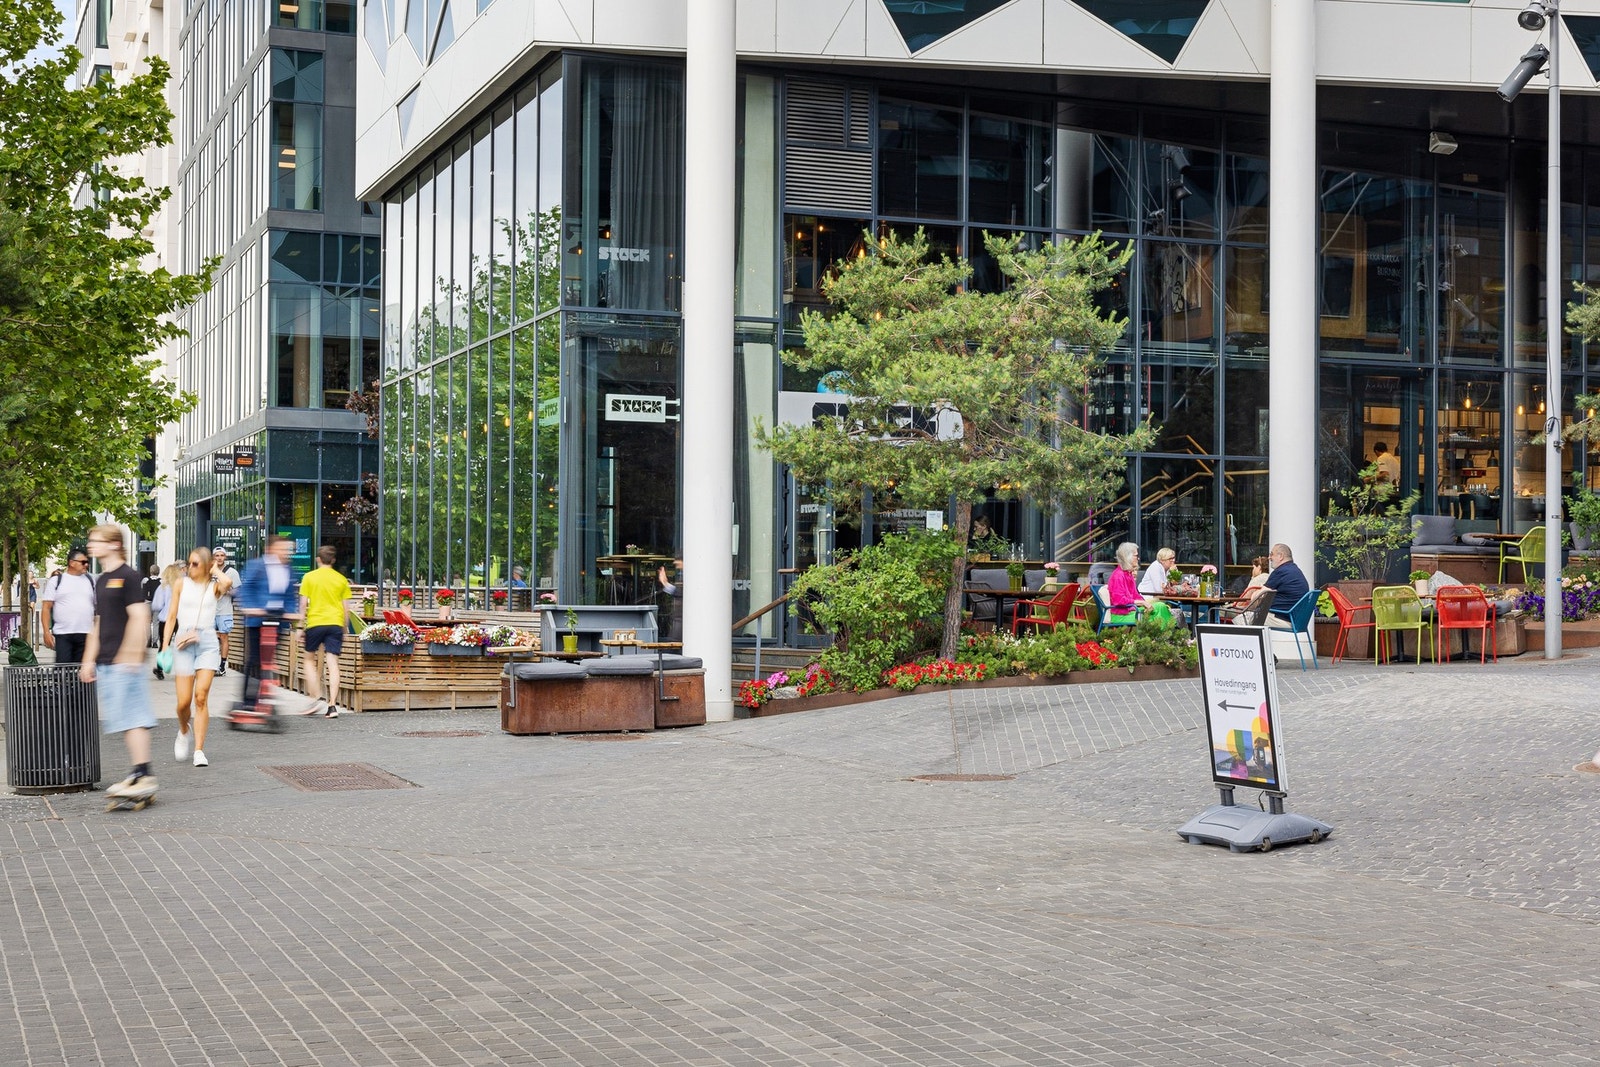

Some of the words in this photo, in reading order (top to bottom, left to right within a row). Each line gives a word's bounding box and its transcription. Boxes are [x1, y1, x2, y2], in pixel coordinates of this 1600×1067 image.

[599, 247, 650, 262] STOCK
[611, 399, 662, 414] STOCK
[801, 504, 819, 513] STOCK
[896, 509, 927, 518] STOCK
[217, 528, 243, 537] TOPPERS
[1220, 648, 1254, 660] FOTO.NO
[1214, 677, 1256, 691] Hovedinngang
